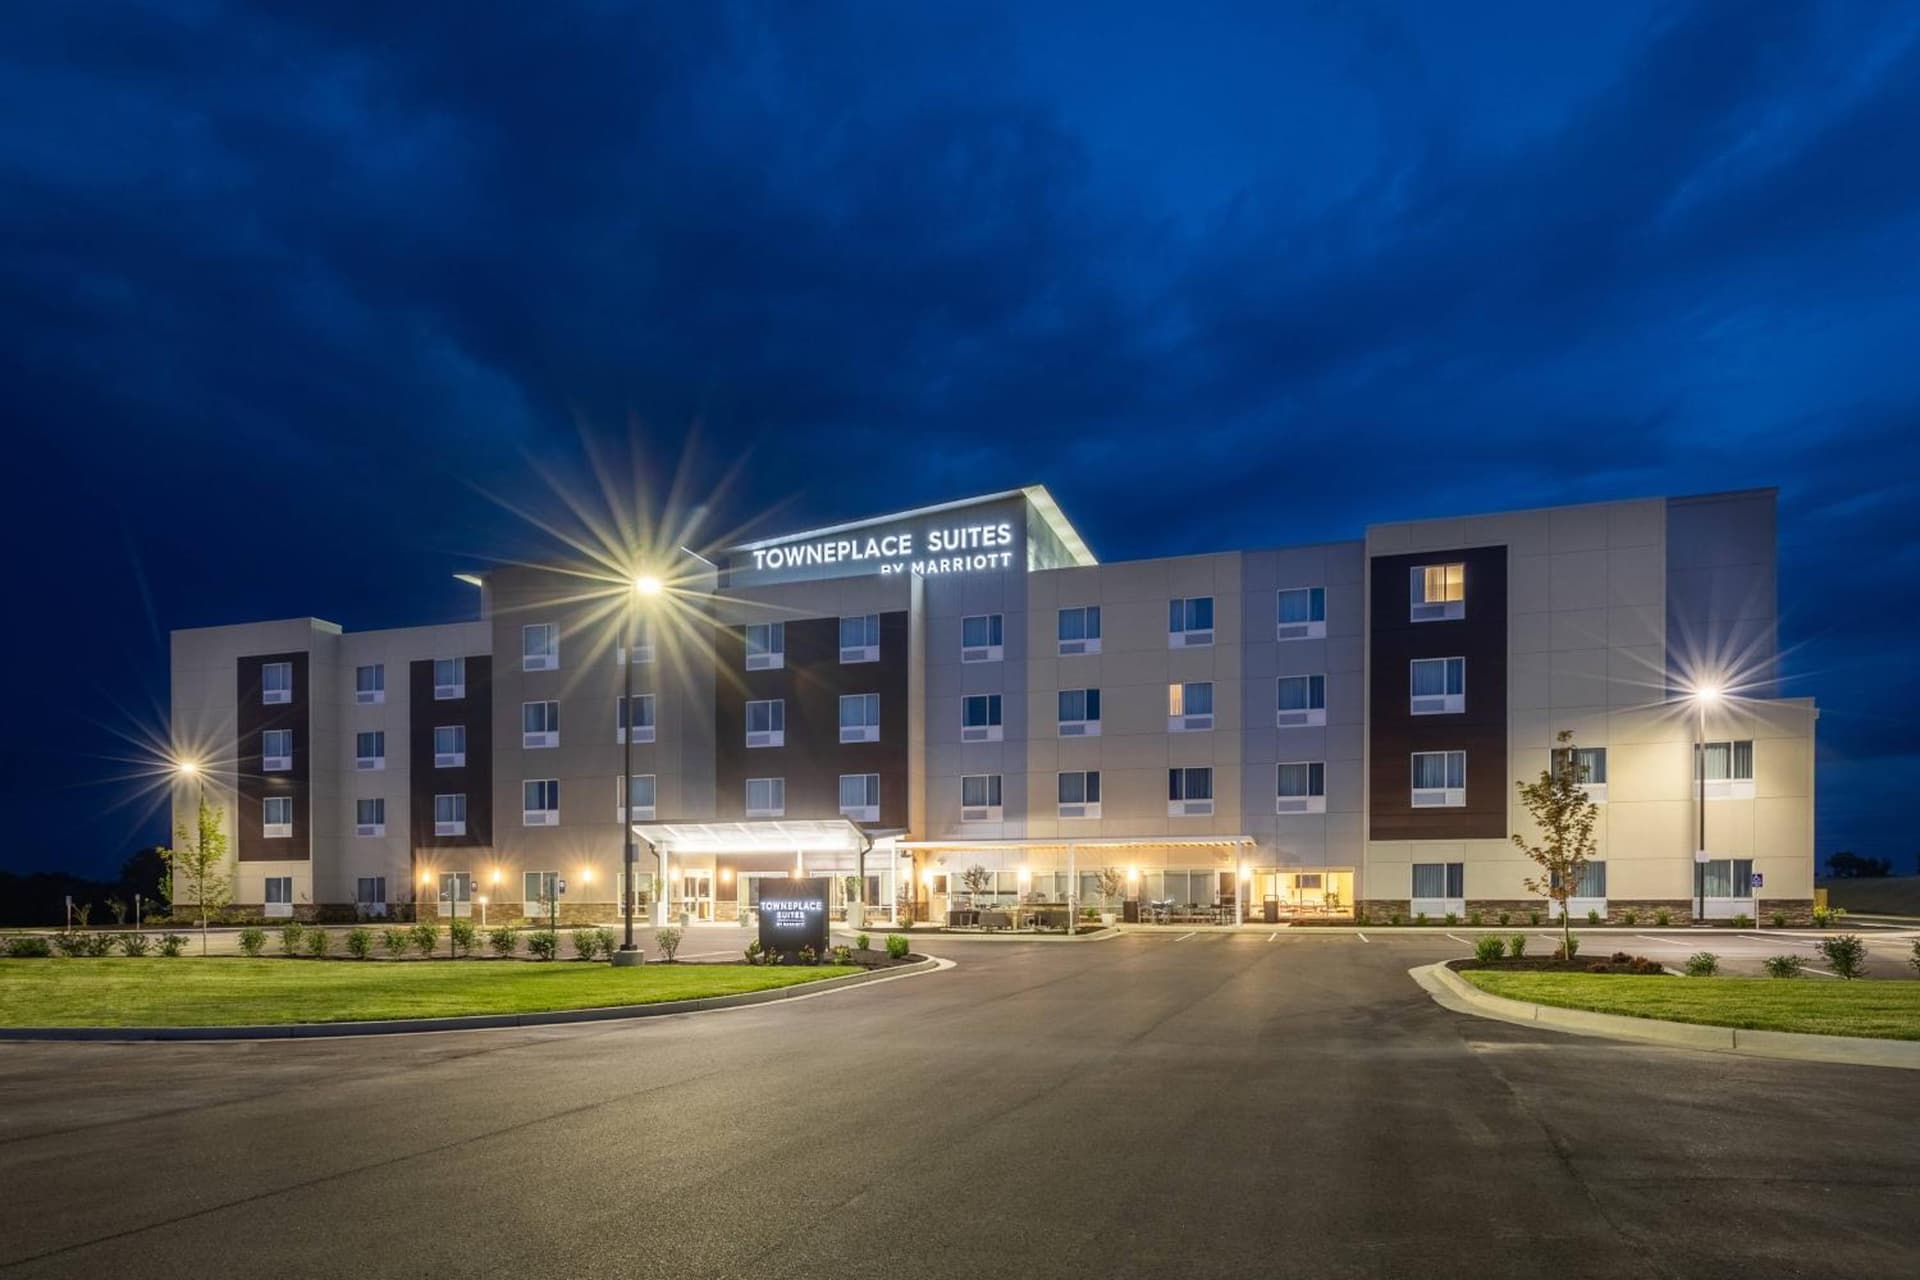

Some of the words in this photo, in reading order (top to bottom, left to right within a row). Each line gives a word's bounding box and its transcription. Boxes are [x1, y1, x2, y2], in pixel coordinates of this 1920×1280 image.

[753, 534, 912, 569] TOWNEPLACE
[928, 524, 1012, 552] SUITES
[912, 552, 1012, 575] MARRIOTT
[761, 901, 822, 911] TOWNEPLACE
[777, 911, 805, 919] SUITES
